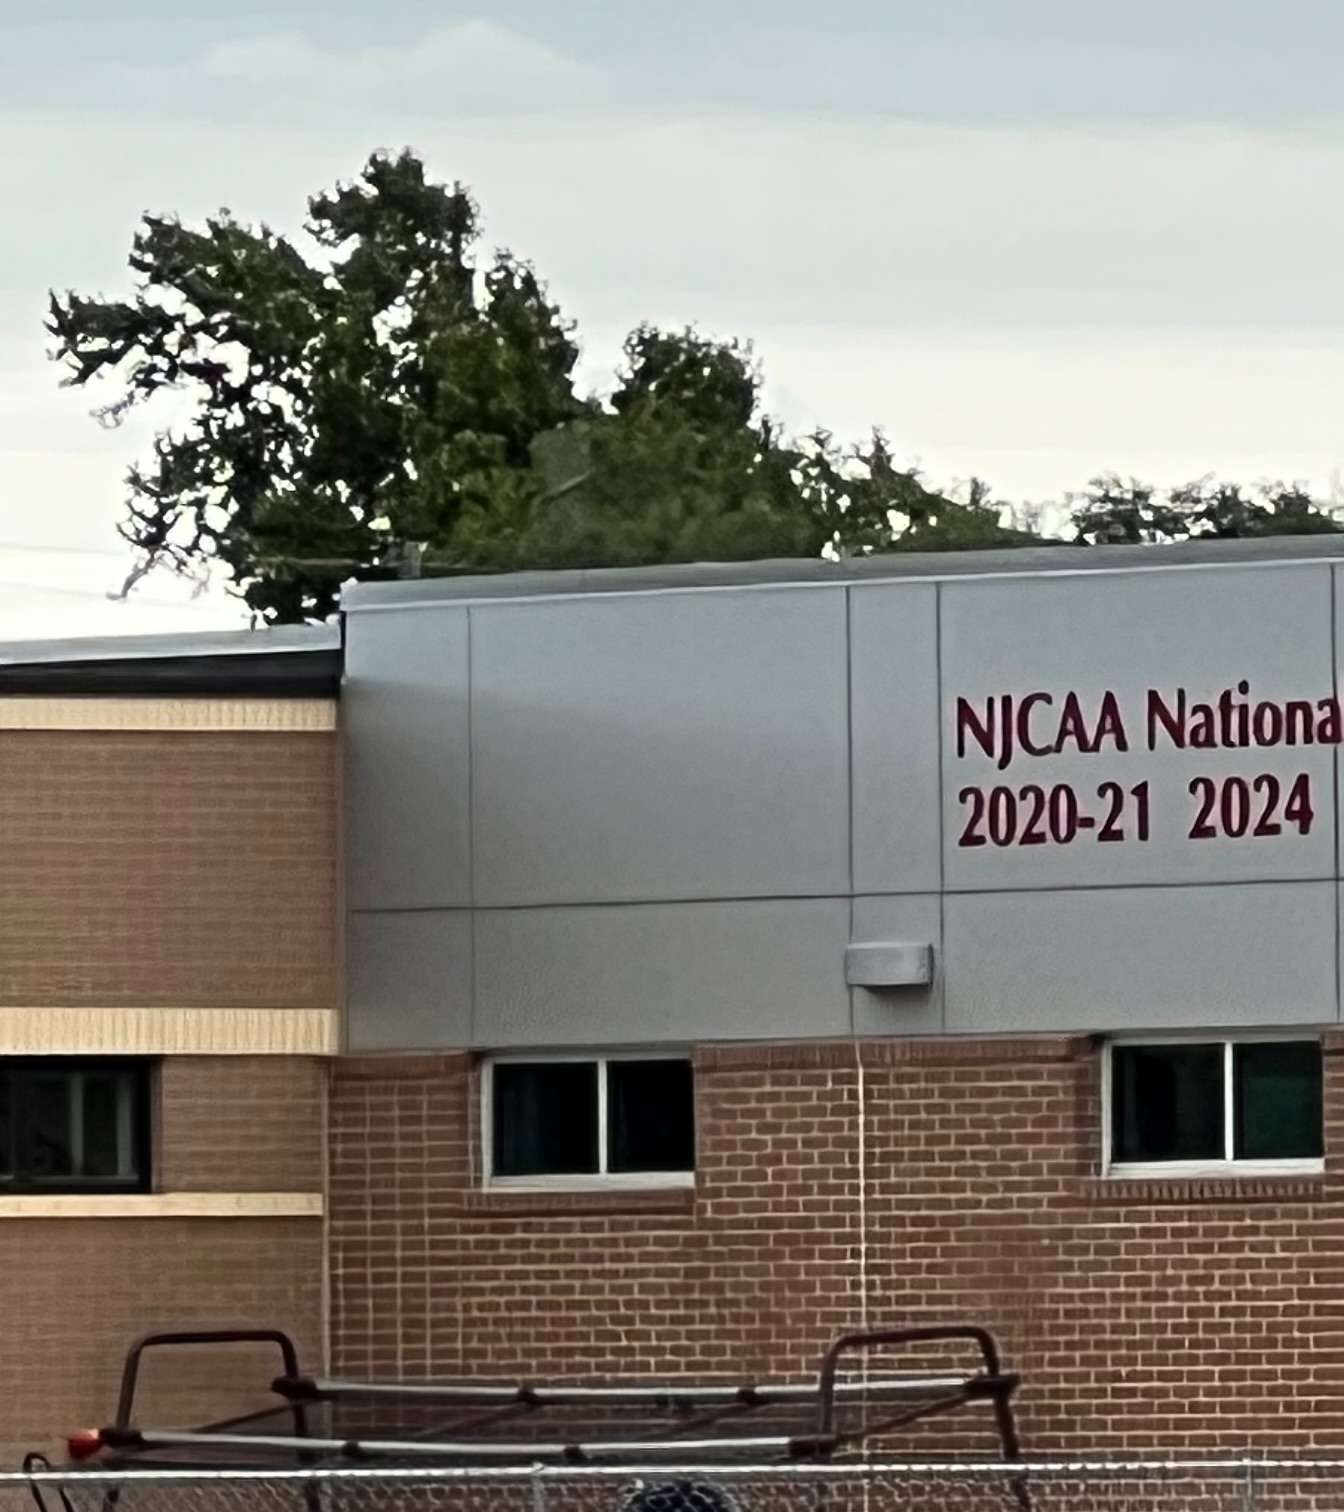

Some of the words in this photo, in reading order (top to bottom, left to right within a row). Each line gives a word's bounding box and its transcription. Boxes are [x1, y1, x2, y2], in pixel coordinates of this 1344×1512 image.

[957, 690, 1128, 770] NJCAA
[958, 781, 1151, 847] 2020-21
[1188, 773, 1315, 839] 2024
